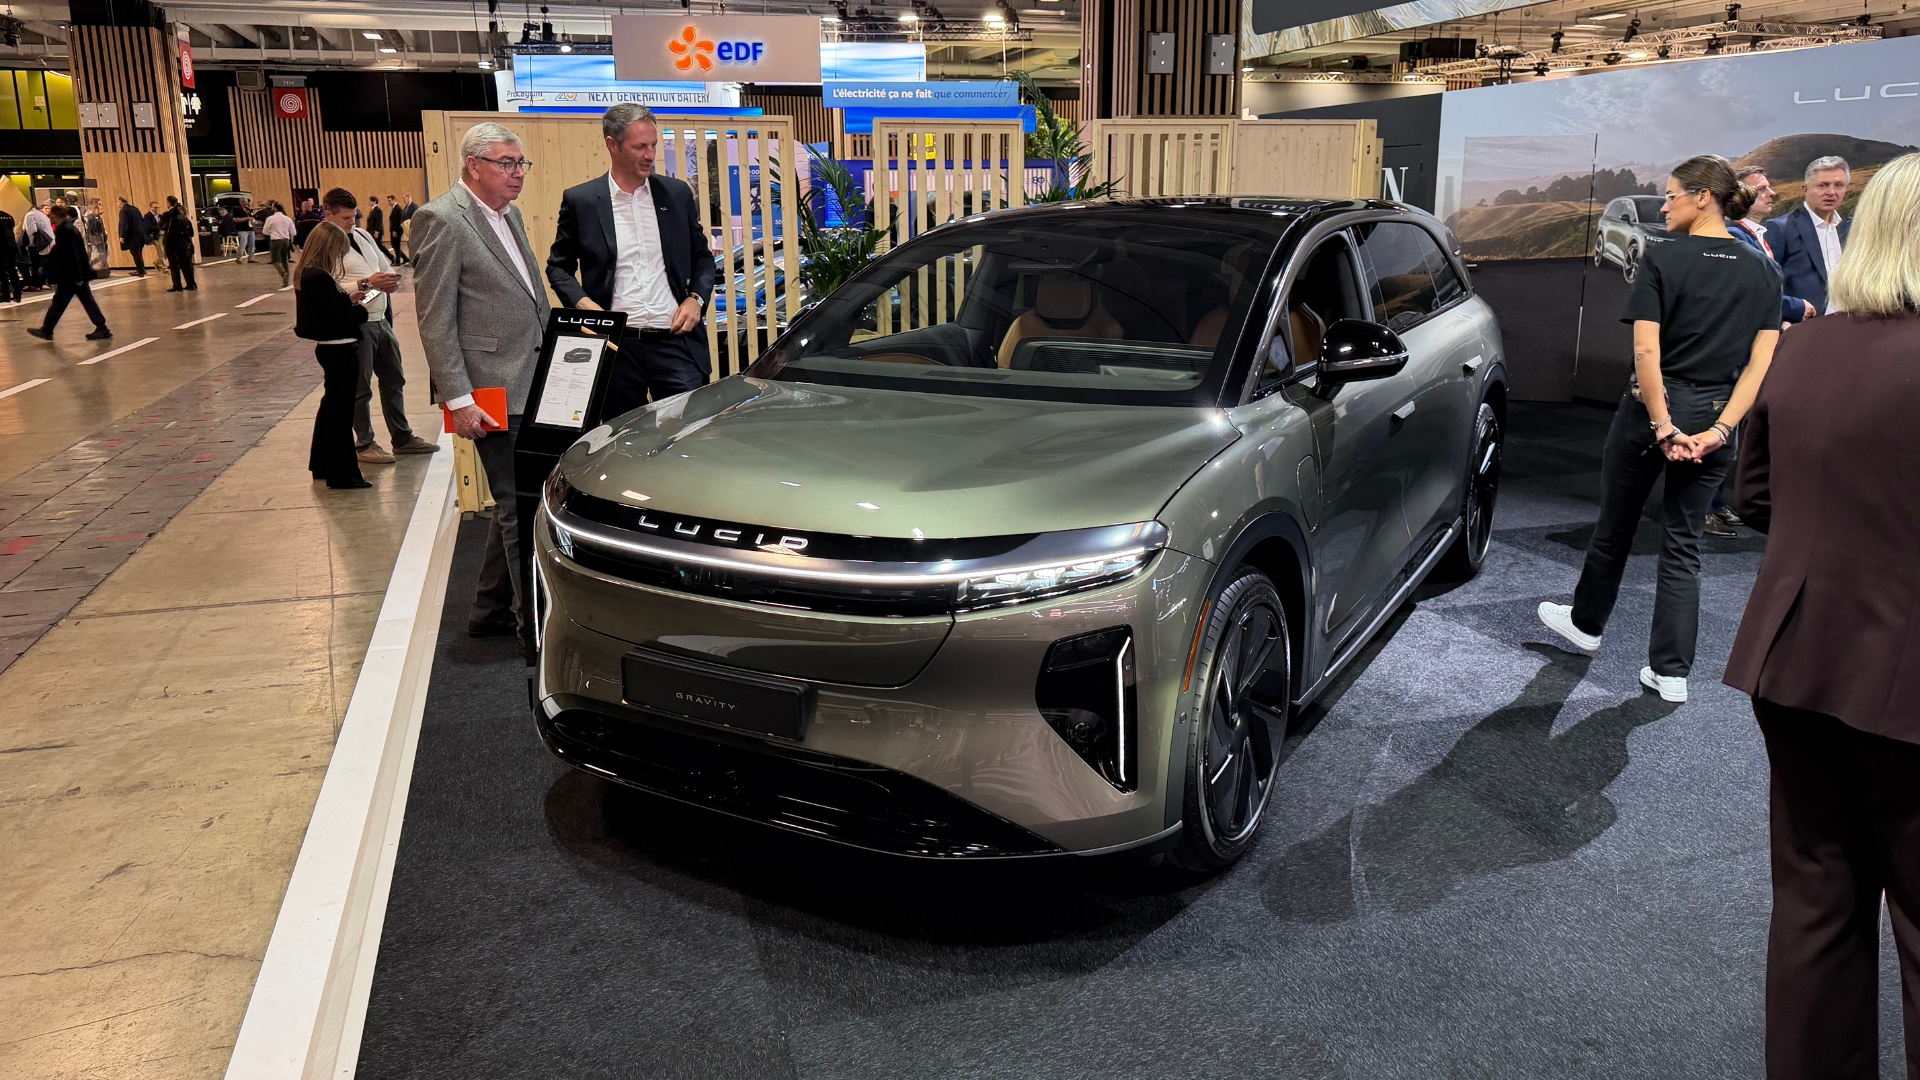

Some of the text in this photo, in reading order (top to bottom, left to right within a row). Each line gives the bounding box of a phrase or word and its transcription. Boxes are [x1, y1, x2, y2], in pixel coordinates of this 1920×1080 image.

[588, 91, 710, 103] NEXT GENERATION BATTERY
[833, 88, 886, 98] L'électricité
[888, 90, 899, 100] ça
[901, 90, 913, 98] ne
[915, 88, 932, 98] fait
[934, 91, 951, 101] que
[557, 316, 615, 326] LUCID
[638, 515, 809, 550] LUCID
[675, 692, 736, 711] GRAVITY
